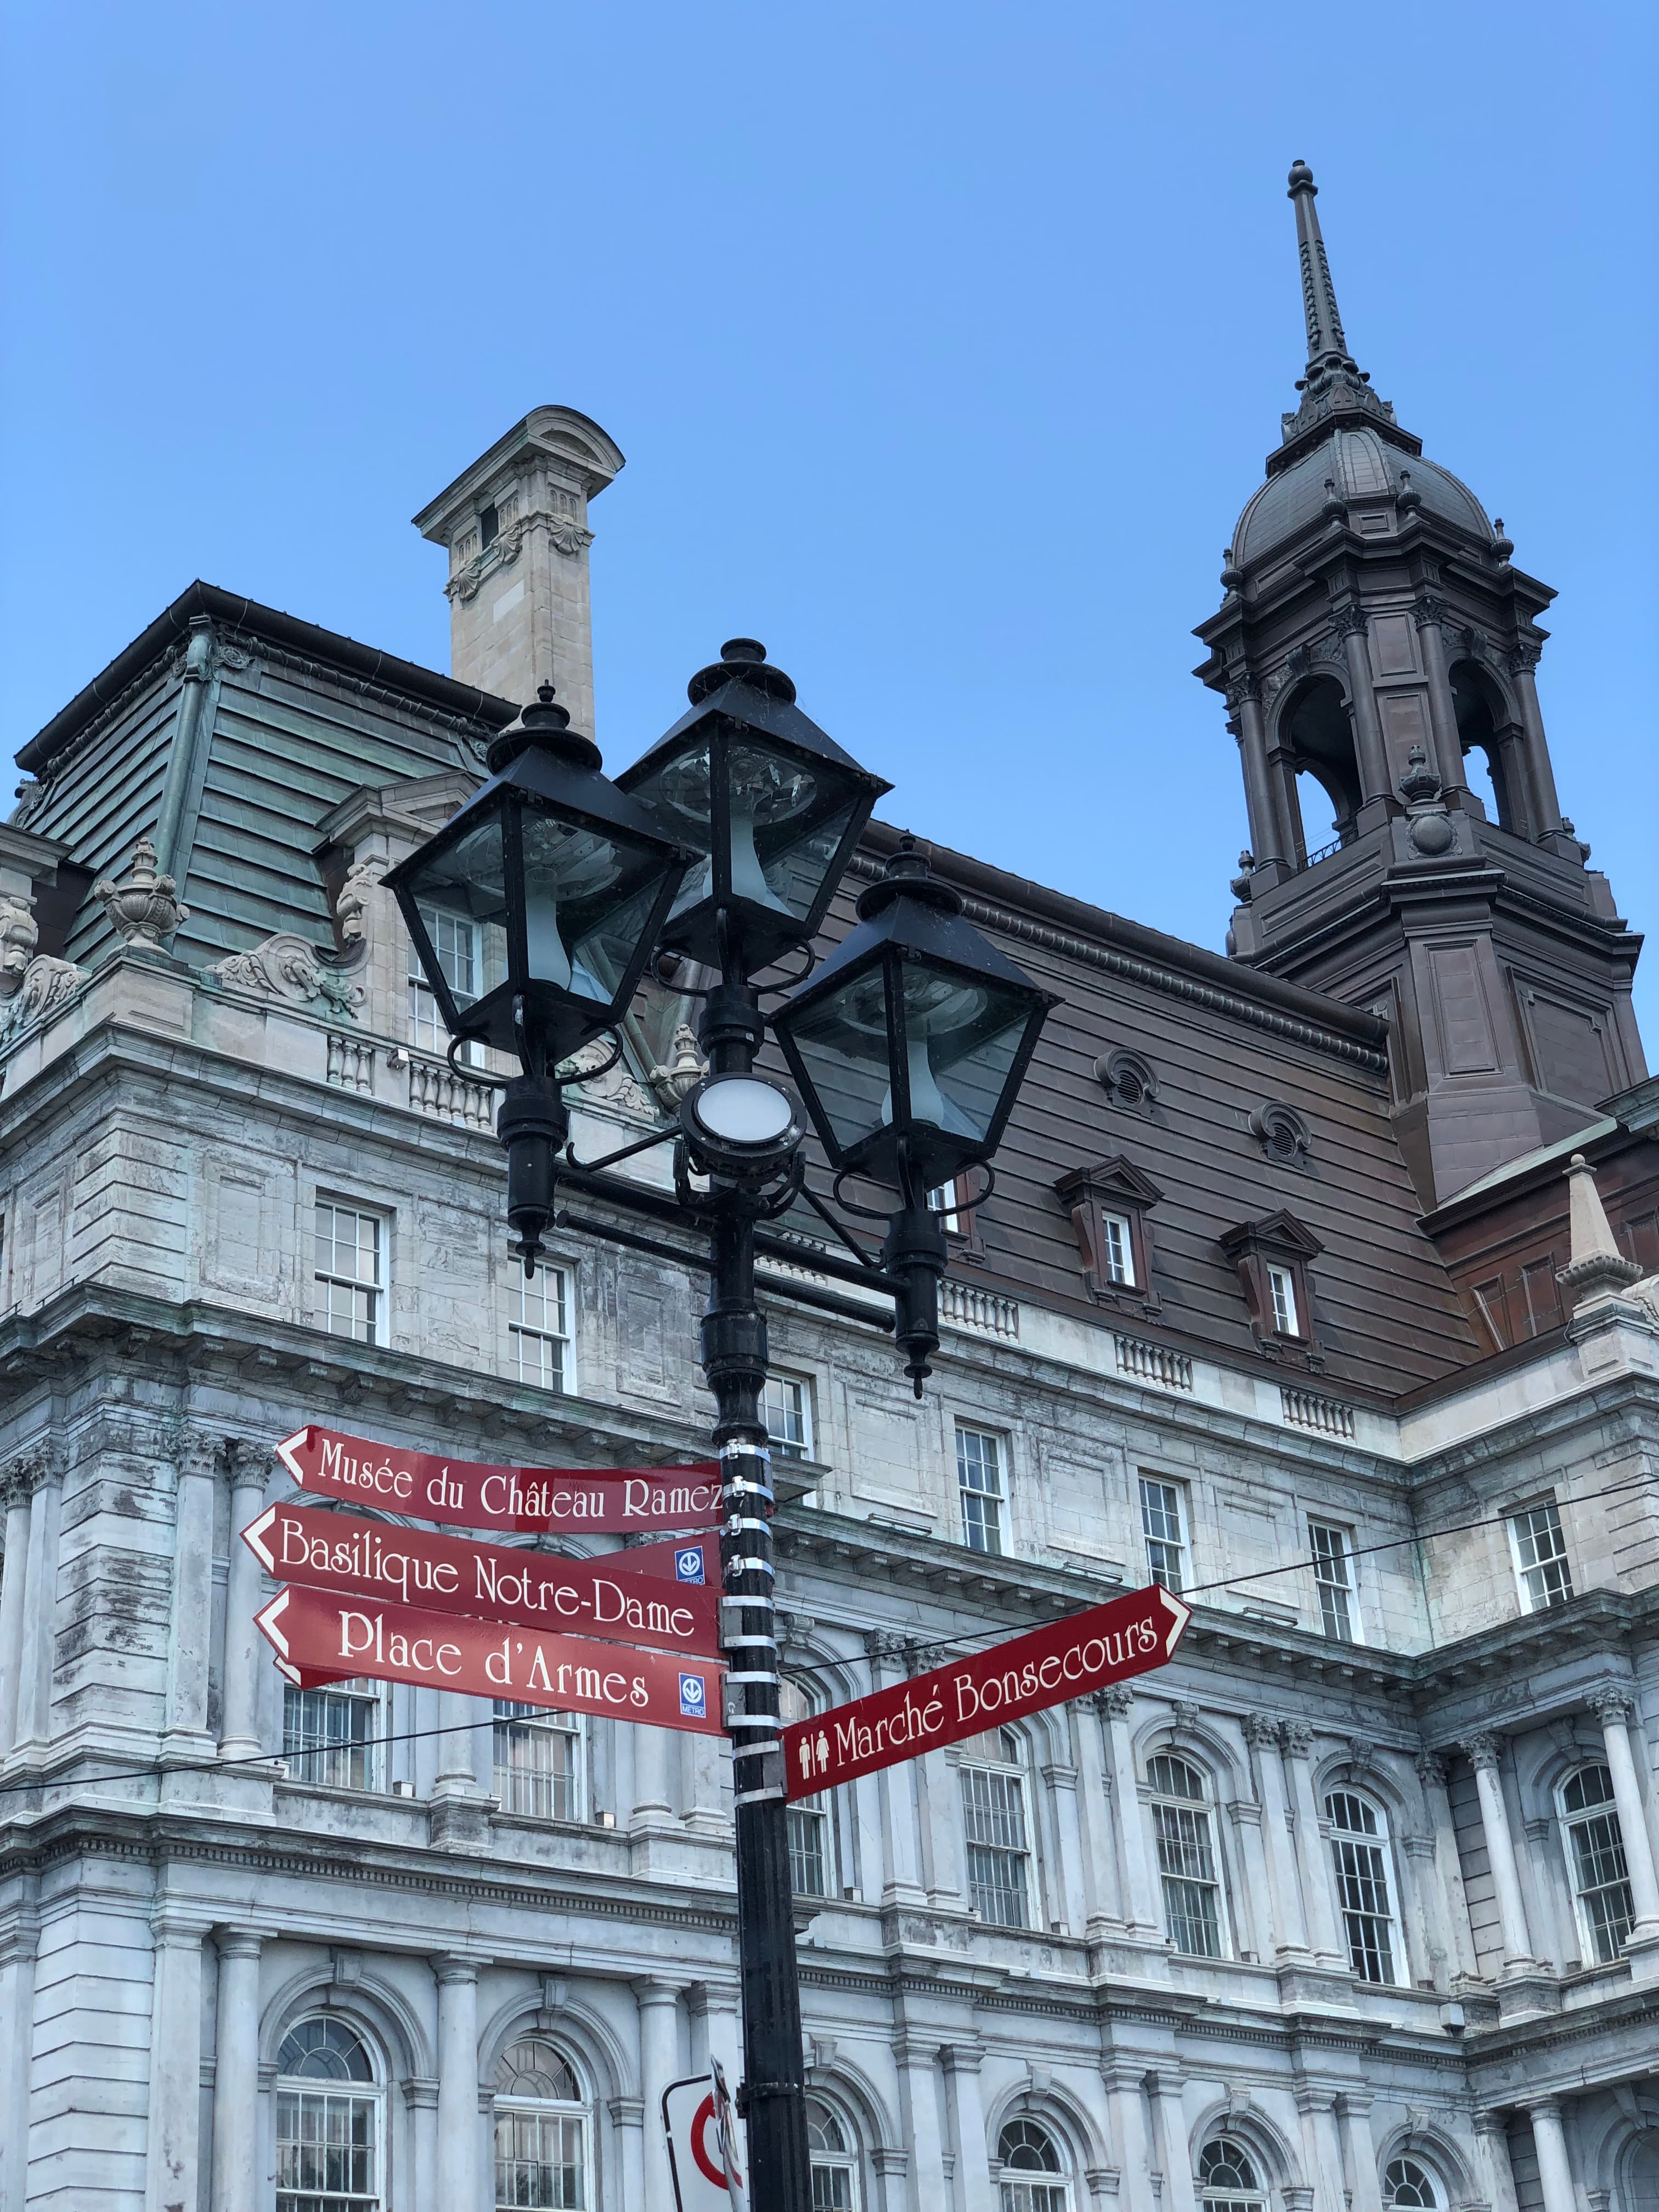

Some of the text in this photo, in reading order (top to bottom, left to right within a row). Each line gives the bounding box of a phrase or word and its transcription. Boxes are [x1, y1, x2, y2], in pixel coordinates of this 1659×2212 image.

[318, 1438, 413, 1498] Musée
[427, 1466, 464, 1509] du
[481, 1475, 605, 1518] Château
[279, 1518, 695, 1637] Basilique Notre-Dame
[337, 1610, 649, 1707] Place d'Armes
[834, 1616, 1157, 1767] Marché Bonsecours
[682, 1705, 704, 1716] METRO
